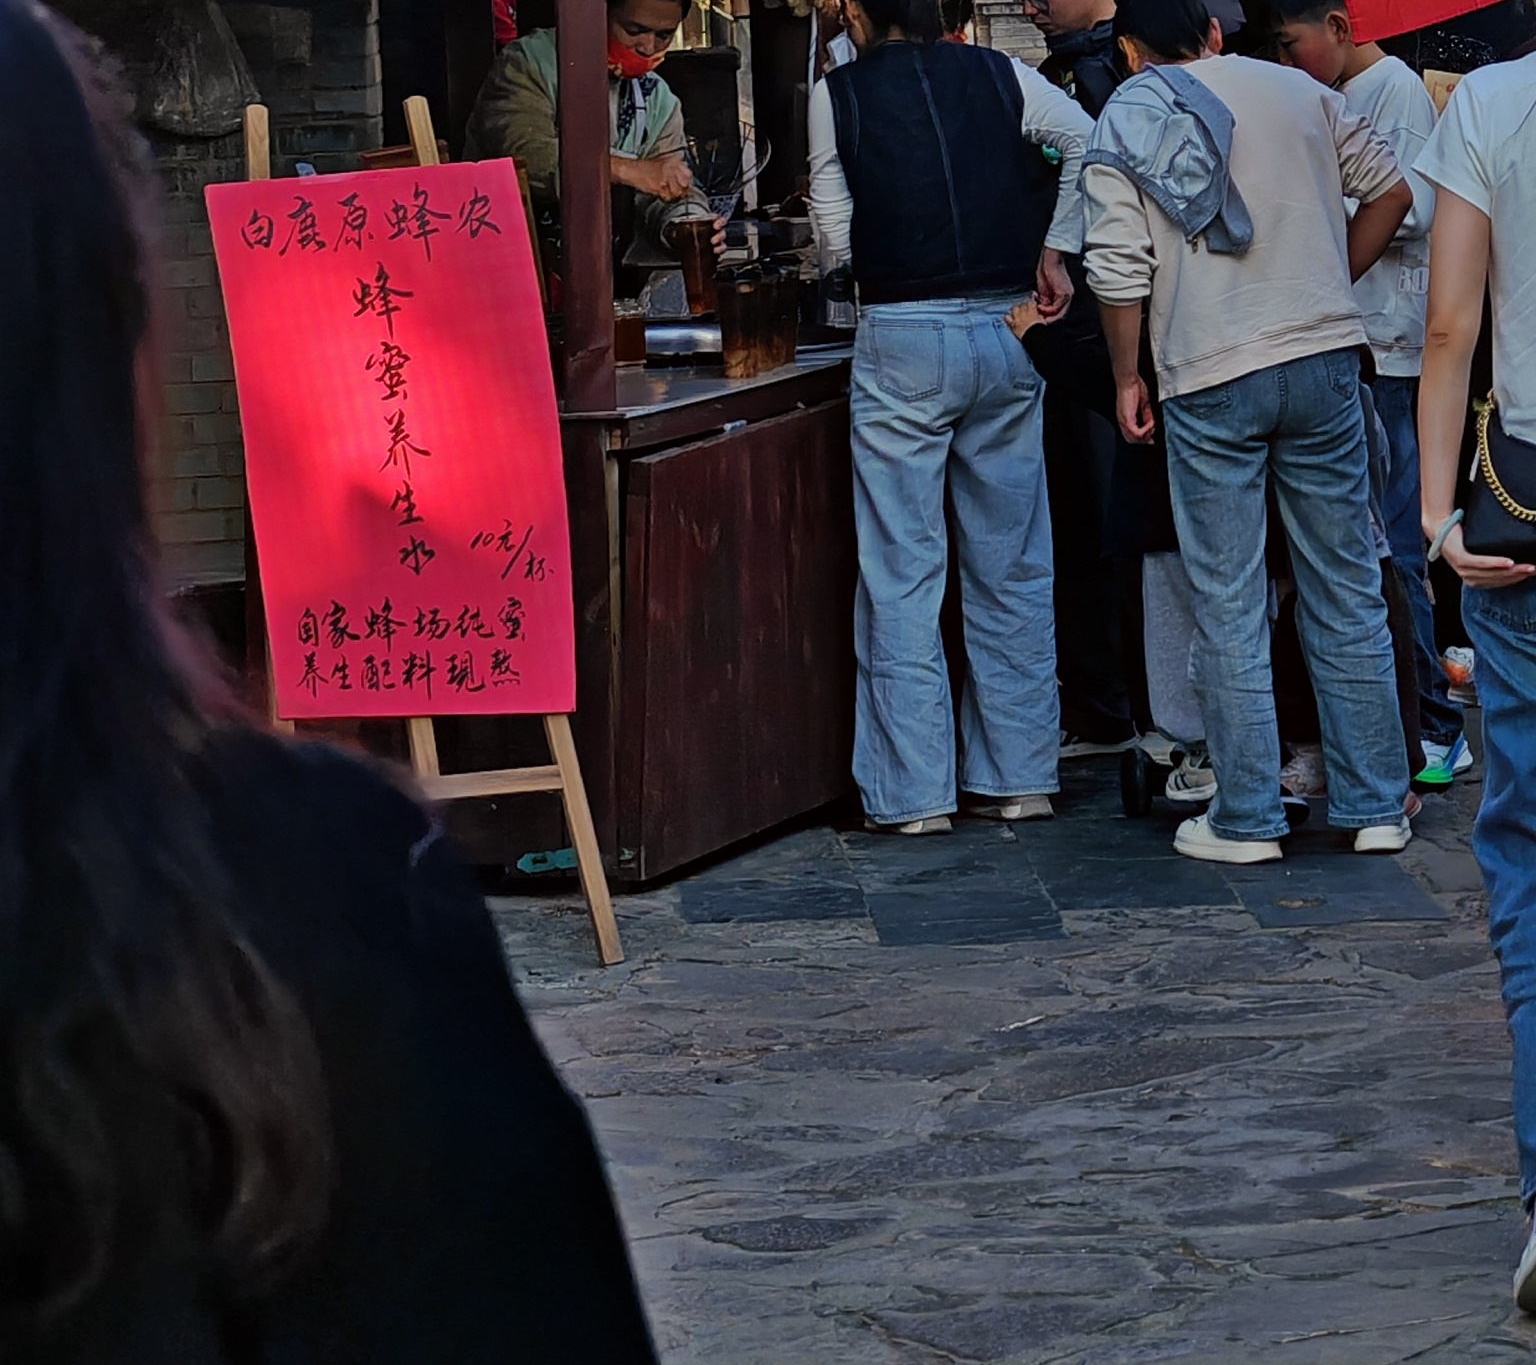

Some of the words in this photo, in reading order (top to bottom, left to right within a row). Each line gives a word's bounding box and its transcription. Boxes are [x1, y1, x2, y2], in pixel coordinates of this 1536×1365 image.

[241, 182, 502, 262] 白鹿原蜂农
[352, 261, 436, 576] 蜂蜜养生水
